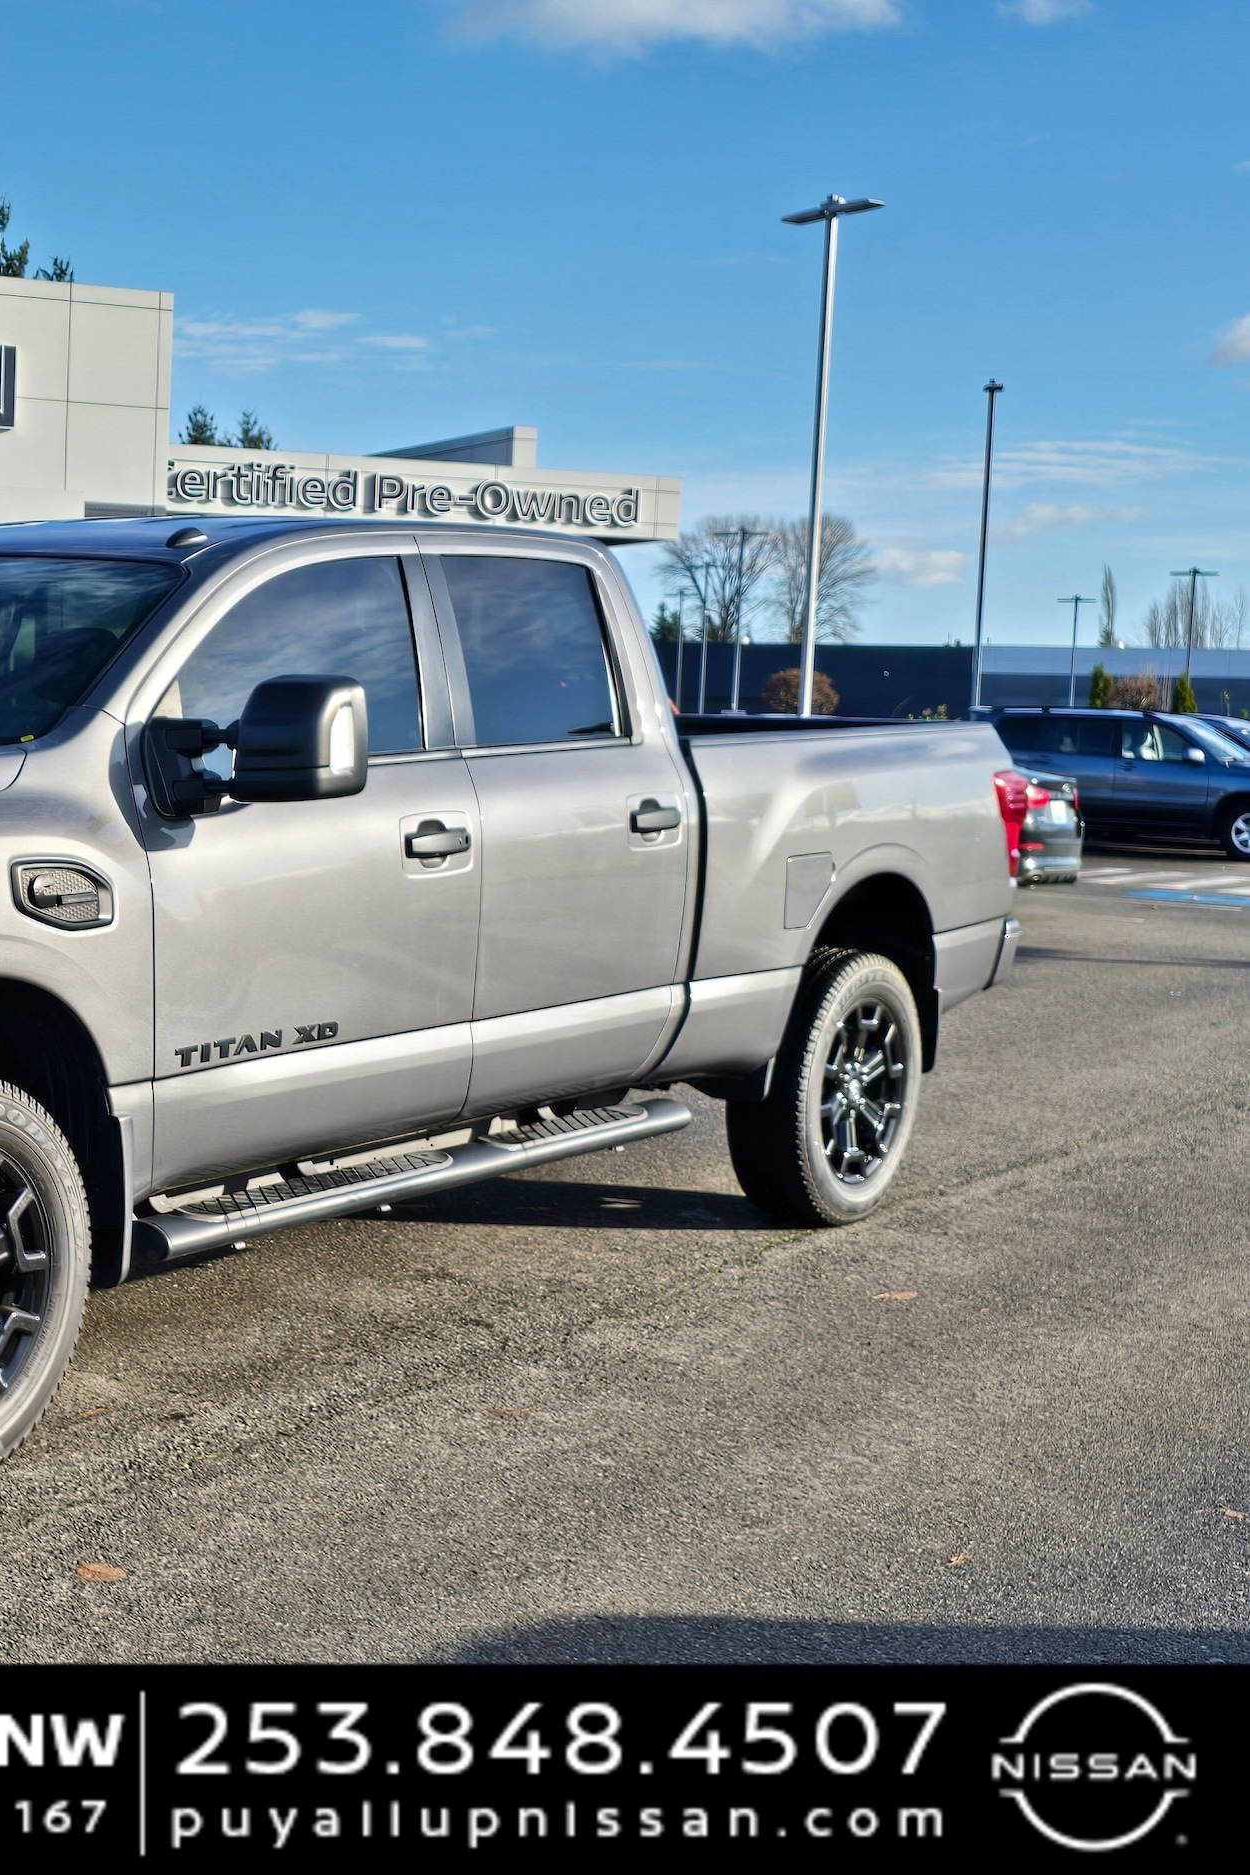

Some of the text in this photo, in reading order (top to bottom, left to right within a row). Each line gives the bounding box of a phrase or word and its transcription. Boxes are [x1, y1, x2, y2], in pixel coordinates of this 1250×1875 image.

[167, 460, 643, 527] ertified Pre-Owned
[174, 1021, 339, 1068] TITAN XD
